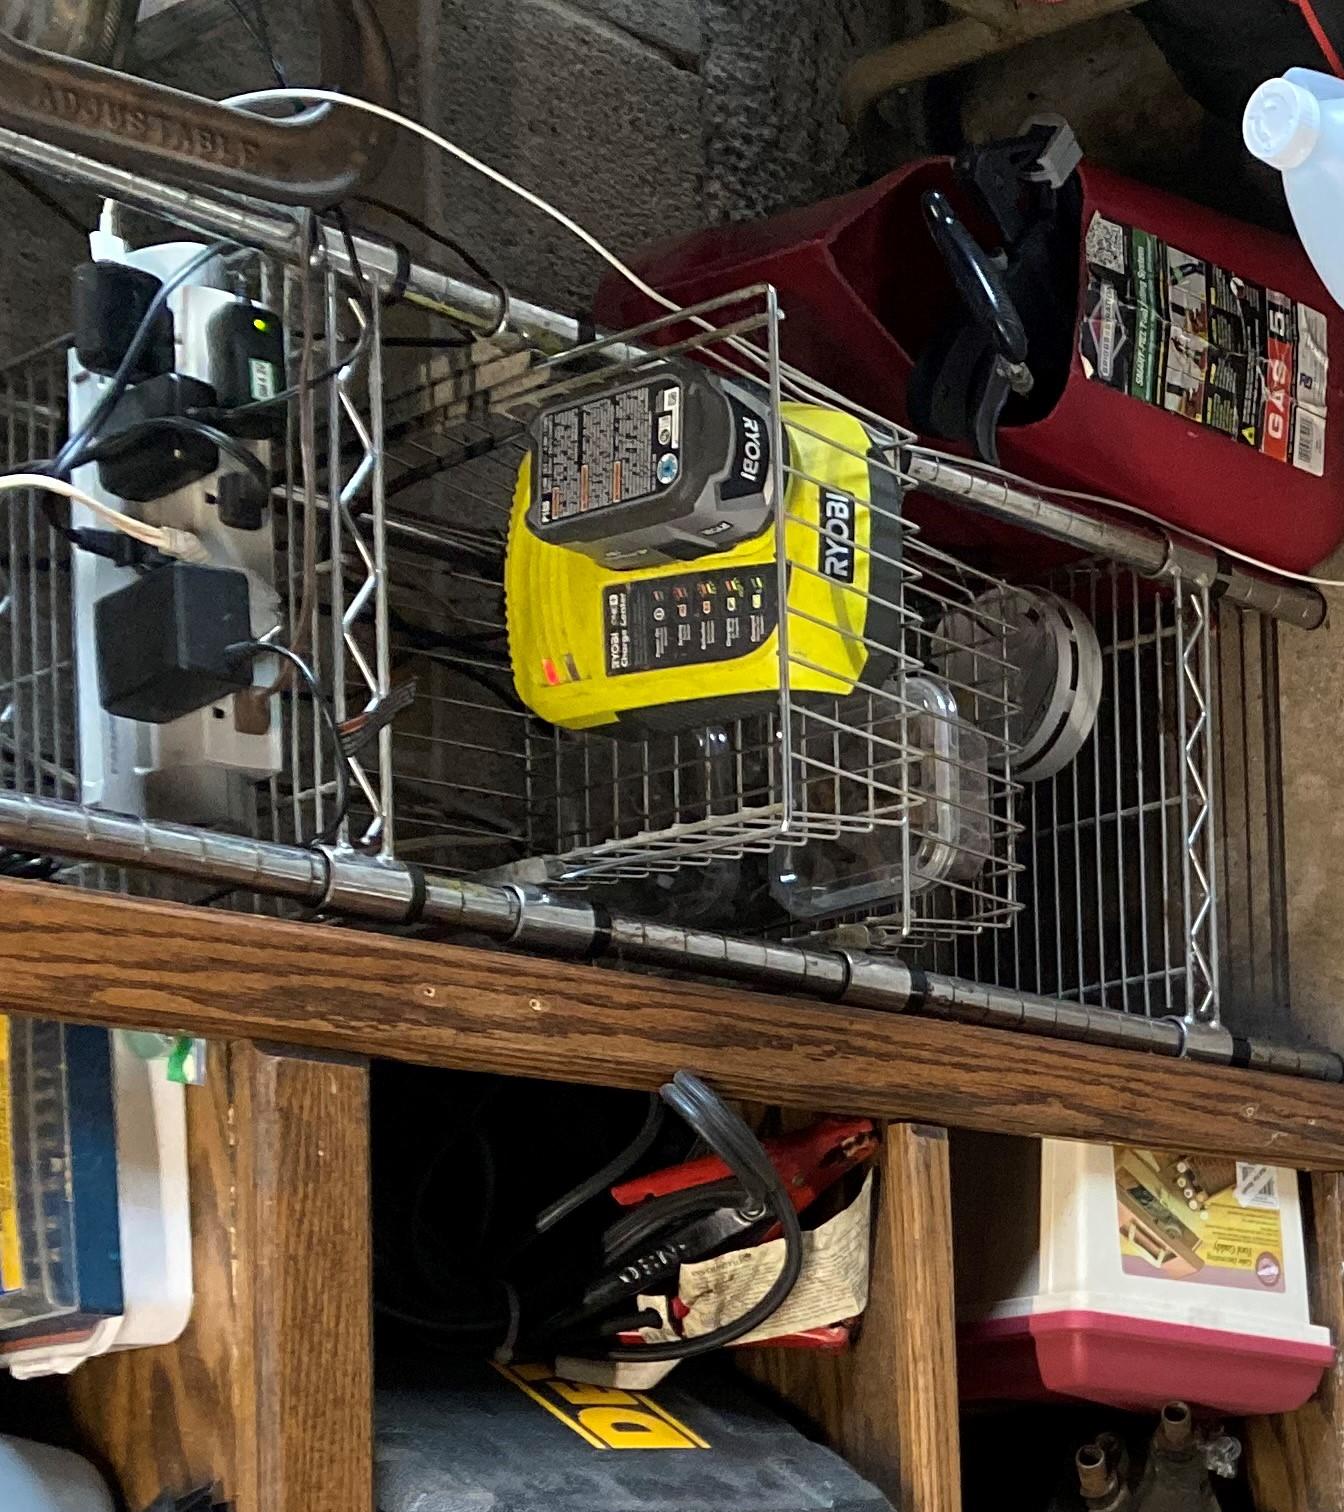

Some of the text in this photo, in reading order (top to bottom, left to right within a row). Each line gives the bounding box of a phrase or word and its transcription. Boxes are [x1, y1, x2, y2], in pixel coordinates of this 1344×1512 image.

[1269, 310, 1285, 336] 5
[1267, 360, 1285, 440] GAS
[740, 416, 760, 481] RYOBI
[825, 492, 849, 577] RYOBI
[610, 631, 620, 669] RYOBI
[620, 630, 629, 668] Charge
